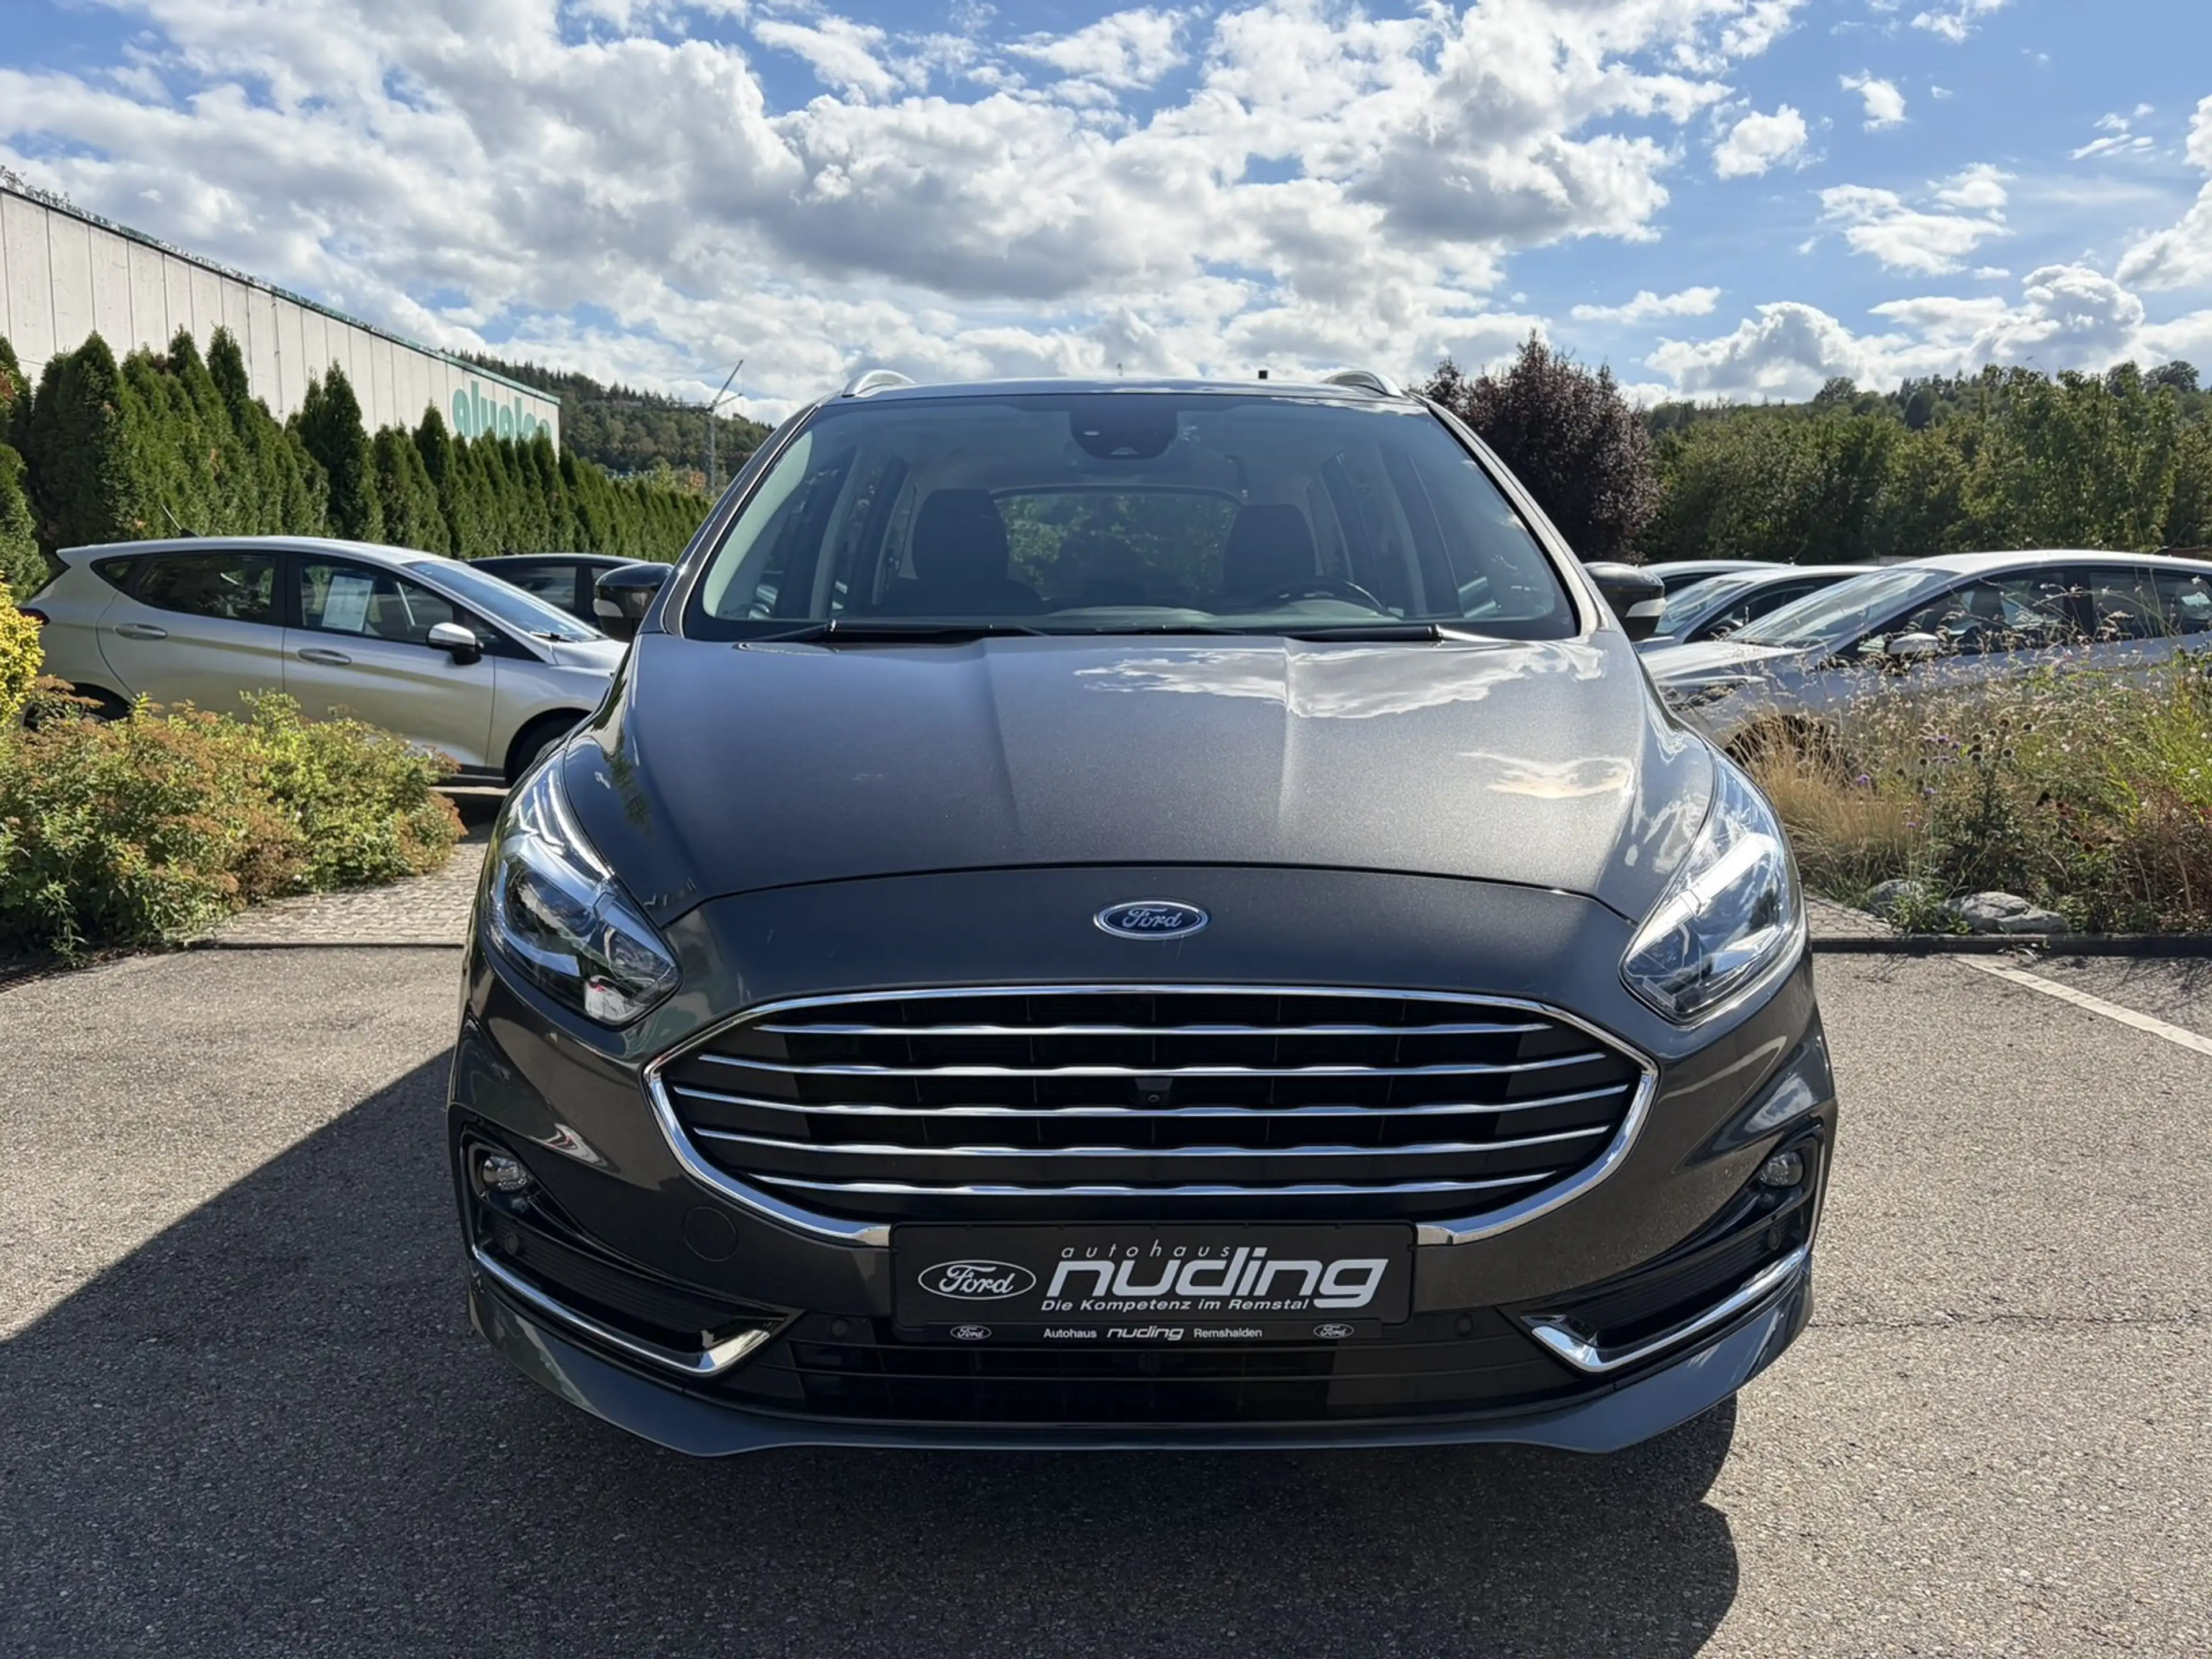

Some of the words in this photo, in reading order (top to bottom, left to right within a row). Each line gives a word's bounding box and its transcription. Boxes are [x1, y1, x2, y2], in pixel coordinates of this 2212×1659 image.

[1122, 908, 1183, 928] Ford
[1061, 1239, 1230, 1258] autohaus
[938, 1264, 1016, 1294] Ford
[1046, 1247, 1389, 1308] nuding
[1041, 1299, 1073, 1311] Die
[1080, 1299, 1192, 1313] Kompetenz
[1198, 1298, 1221, 1310] im
[1228, 1298, 1309, 1310] Remstal
[957, 1327, 984, 1338] Ford
[1043, 1328, 1097, 1338] Autohaus
[1107, 1325, 1184, 1341] nuding
[1194, 1328, 1262, 1338] Remshalden
[1320, 1324, 1348, 1337] Ford
